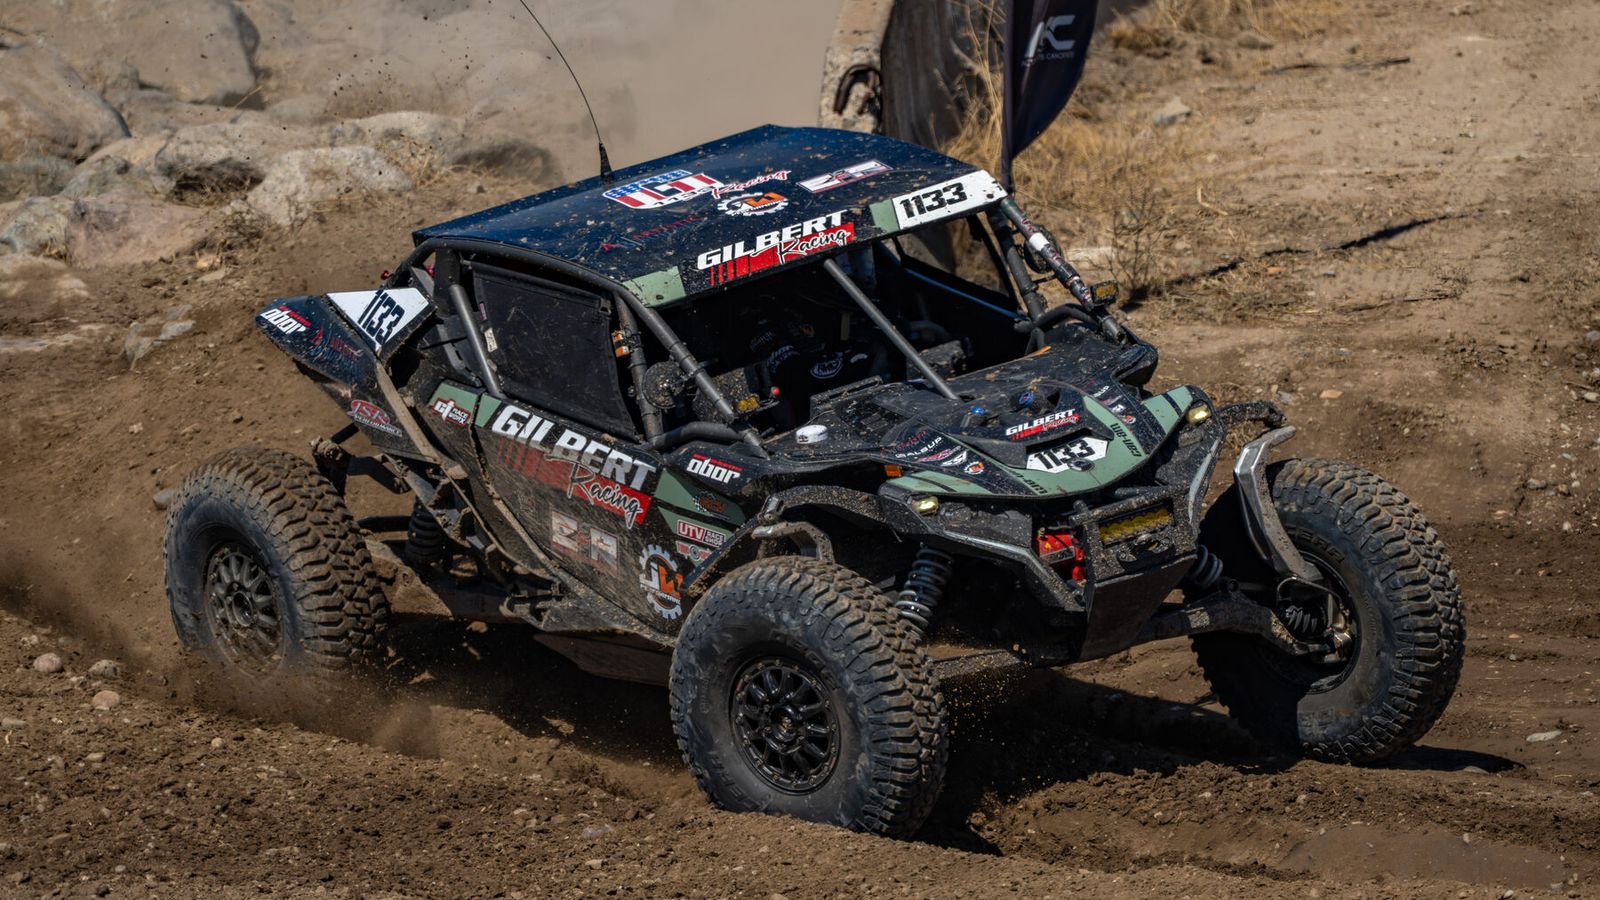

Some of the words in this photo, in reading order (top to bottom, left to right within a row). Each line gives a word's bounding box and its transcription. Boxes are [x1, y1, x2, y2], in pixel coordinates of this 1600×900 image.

[899, 182, 968, 219] 1133
[697, 210, 848, 270] GILBERT
[752, 228, 852, 265] Racing
[357, 289, 405, 345] 1133
[1005, 408, 1076, 436] GILBERT
[492, 404, 657, 491] GILBERT
[1034, 439, 1096, 470] 1133
[548, 457, 642, 530] Racing
[679, 522, 705, 541] UTV
